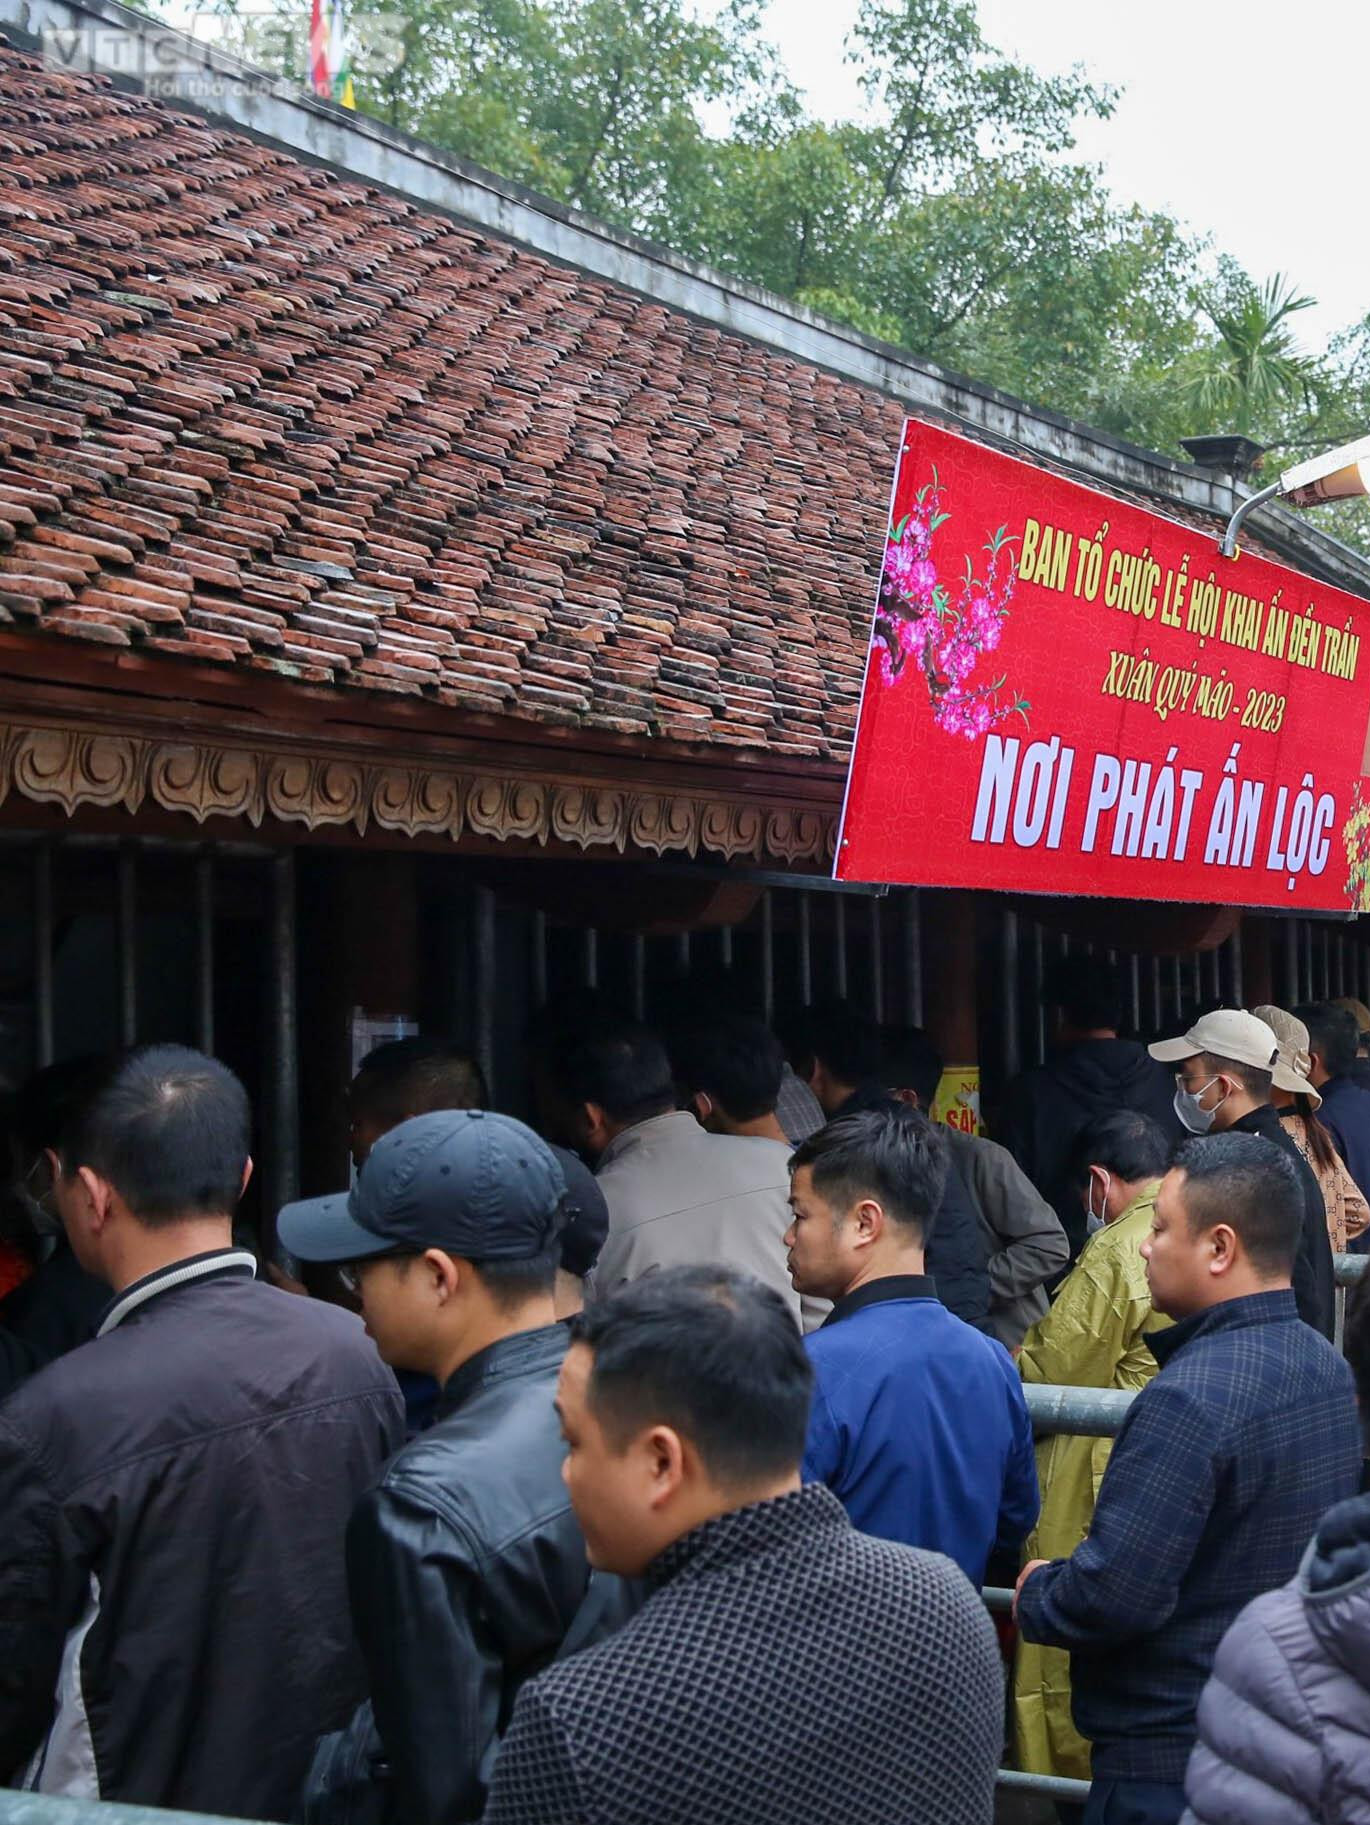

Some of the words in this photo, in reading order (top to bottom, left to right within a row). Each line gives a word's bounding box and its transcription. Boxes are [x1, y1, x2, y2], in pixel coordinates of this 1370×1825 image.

[1018, 517, 1074, 593] BAN
[1073, 520, 1110, 602] TỔ
[1103, 546, 1162, 621] CHỨC
[1160, 553, 1191, 629] LỄ
[1186, 571, 1222, 649] HỘI
[1219, 589, 1265, 652] KHAI
[1261, 588, 1290, 660] ẤN
[1286, 602, 1323, 670] ĐỀN
[1320, 615, 1361, 682] TRẦN
[1101, 646, 1161, 704] XUÂN
[1153, 660, 1198, 722] QUÝ
[1191, 667, 1235, 722] MÃO
[1240, 687, 1287, 734] 2023
[970, 733, 1076, 849] NƠI
[1080, 746, 1205, 862] PHÁT
[1203, 741, 1266, 868] ẤN
[1265, 772, 1336, 892] LỘC
